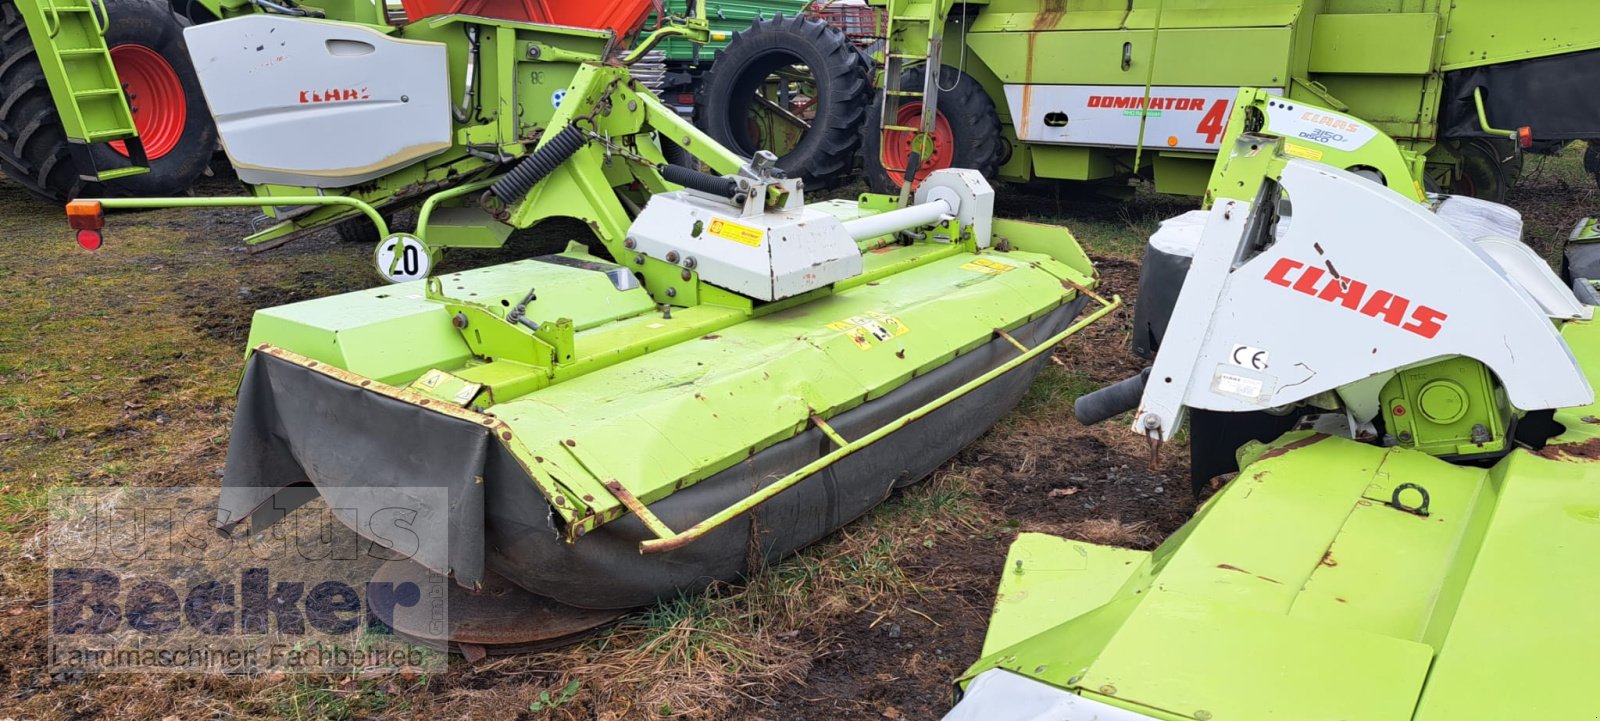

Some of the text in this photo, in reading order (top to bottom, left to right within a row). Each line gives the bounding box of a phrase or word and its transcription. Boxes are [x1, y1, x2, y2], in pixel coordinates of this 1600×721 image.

[1087, 95, 1237, 144] DOMINATOR 4
[1300, 111, 1360, 133] CLAAS
[1298, 131, 1329, 143] DISCO
[387, 244, 419, 276] 20
[1264, 257, 1448, 339] CLAAS
[1233, 346, 1265, 370] CE
